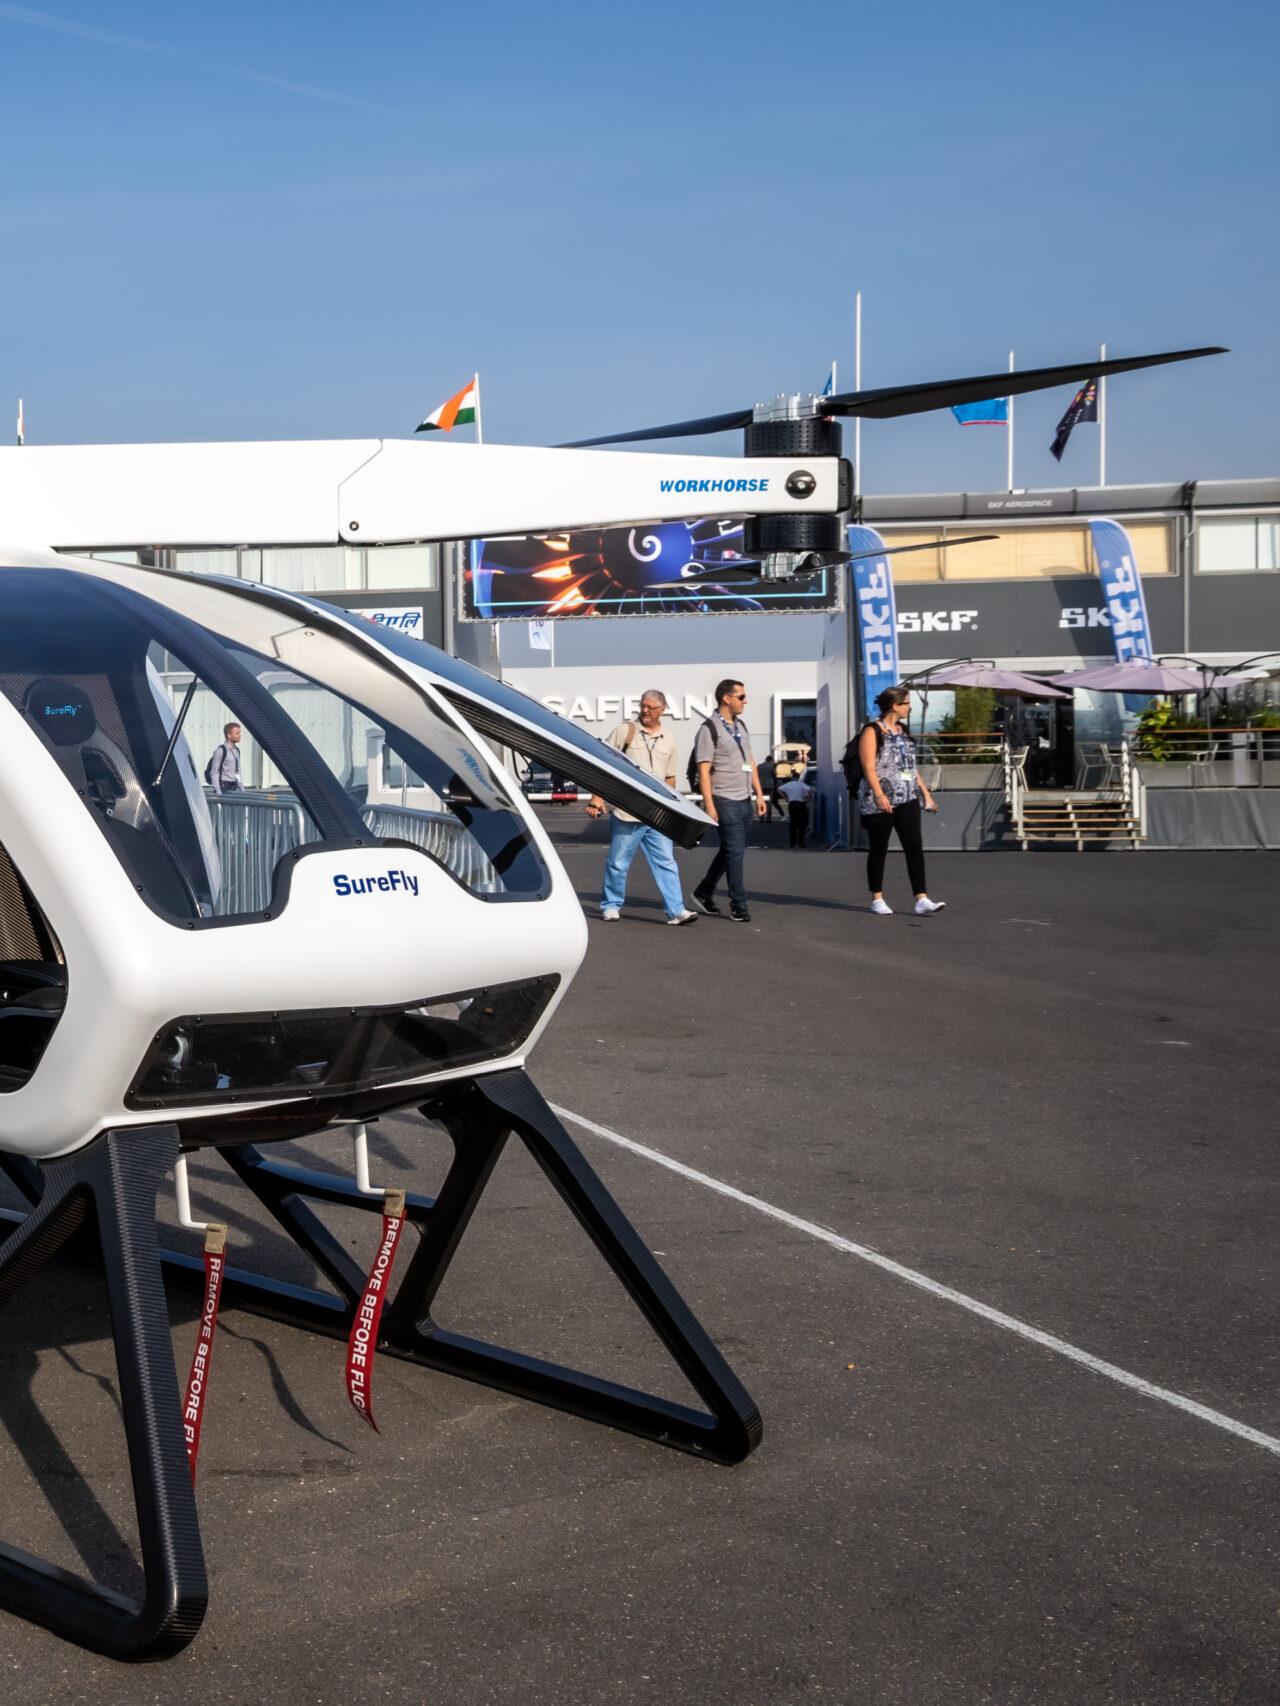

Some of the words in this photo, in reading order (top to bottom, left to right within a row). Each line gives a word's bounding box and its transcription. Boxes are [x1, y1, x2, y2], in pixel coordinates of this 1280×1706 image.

[660, 479, 769, 492] WORKHORSE
[858, 562, 894, 676] SKF
[1059, 607, 1111, 628] SK
[333, 870, 419, 897] SureFly
[368, 1217, 400, 1291] REMOVE
[202, 1257, 222, 1339] REMOVE
[351, 1293, 377, 1368] BEFORE
[185, 1342, 210, 1422] BEFORE
